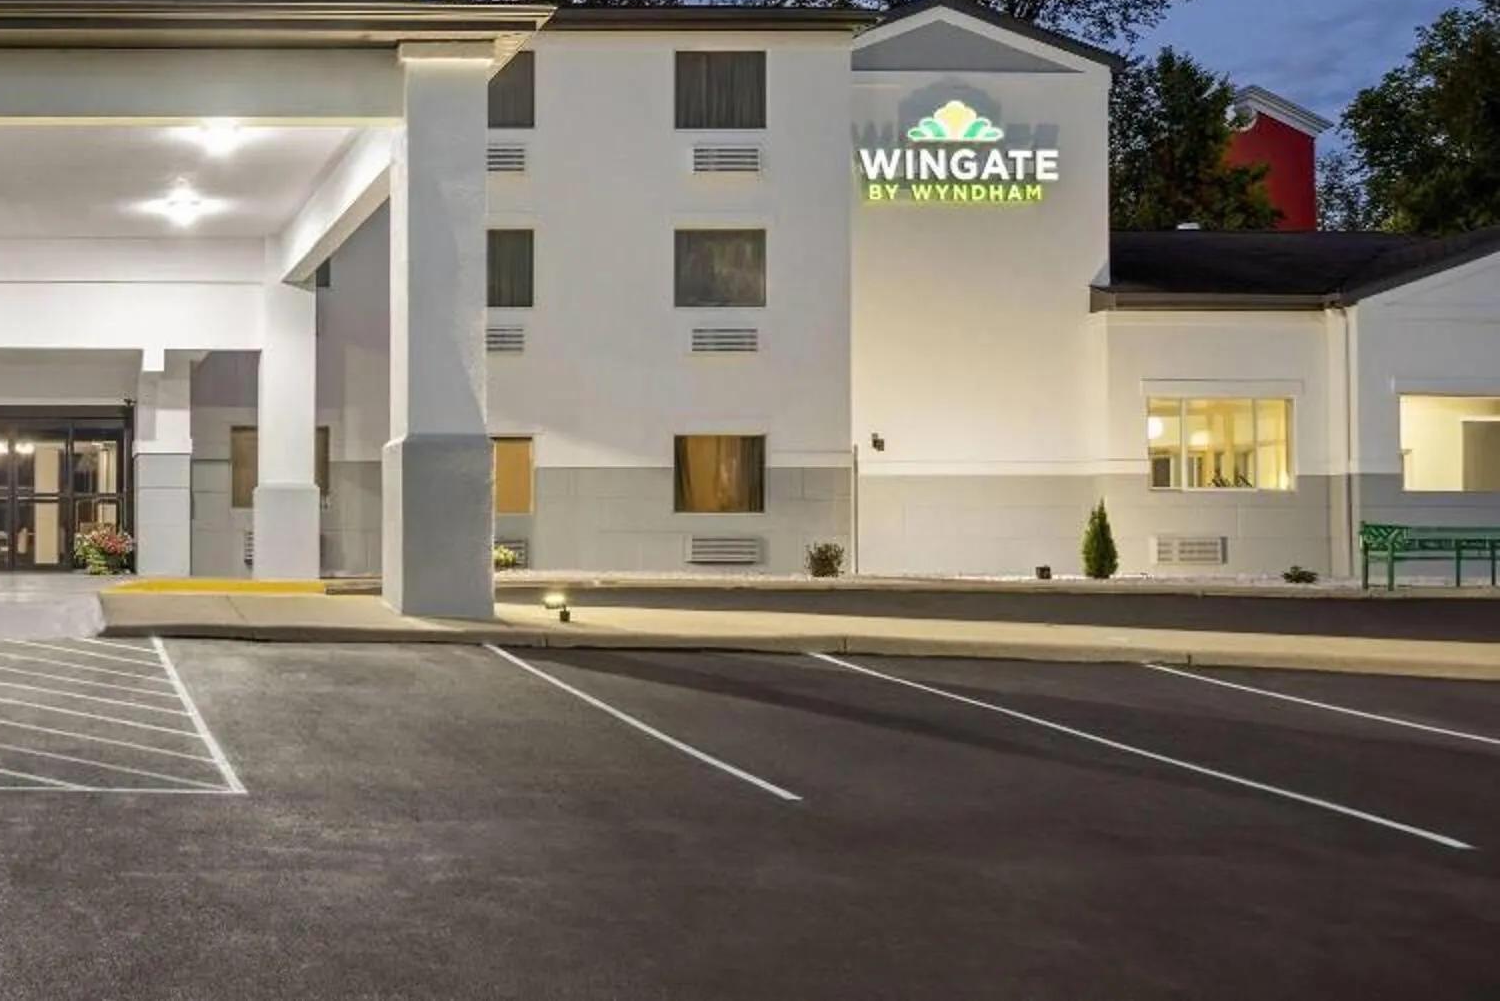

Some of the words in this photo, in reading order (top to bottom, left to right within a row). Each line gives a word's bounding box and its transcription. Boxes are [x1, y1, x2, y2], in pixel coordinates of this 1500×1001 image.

[860, 149, 1059, 180] WINGATE
[869, 184, 898, 200] BY
[912, 184, 1043, 200] WYNDHAM
